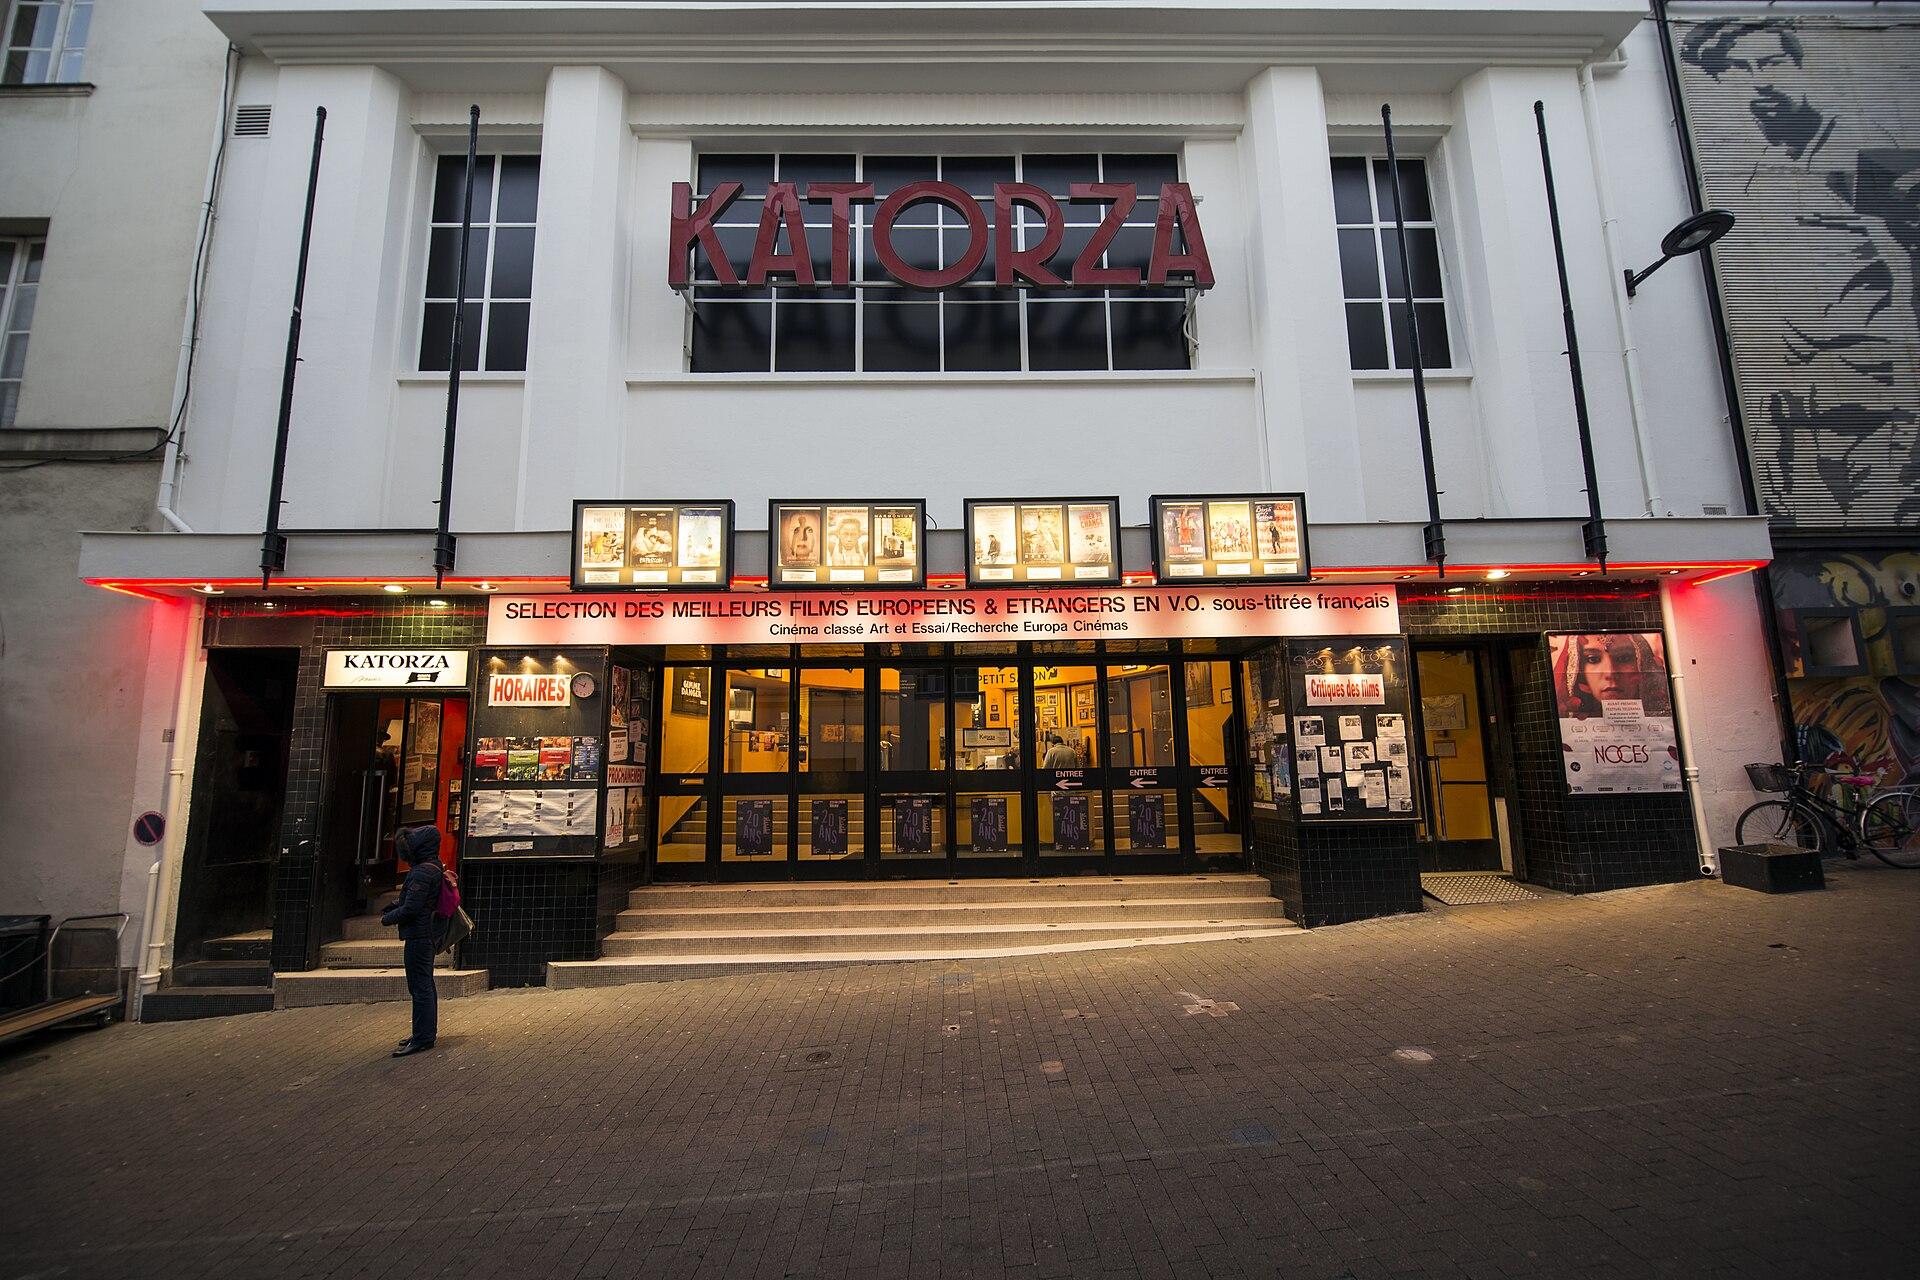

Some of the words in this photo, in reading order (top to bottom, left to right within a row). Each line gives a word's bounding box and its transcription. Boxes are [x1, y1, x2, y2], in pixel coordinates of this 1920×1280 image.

[668, 181, 1215, 290] KATORZA
[505, 602, 616, 619] SELECTION
[624, 601, 664, 618] DES
[672, 601, 782, 618] MEILLEURS
[790, 600, 848, 617] FILMS
[857, 598, 976, 616] EUROPEENS
[984, 598, 998, 615] &
[1006, 597, 1126, 614] ETRANGERS
[1134, 597, 1160, 612] EN
[1168, 596, 1205, 611] V.O.
[1212, 594, 1312, 611] sous-titrée
[1317, 592, 1389, 611] français
[769, 623, 819, 635] Cinéma
[823, 623, 864, 635] classé
[870, 623, 890, 634] Art
[894, 624, 907, 634] et
[912, 621, 1019, 634] Essai/Recherche
[1024, 621, 1068, 634] Europa
[1073, 619, 1129, 632] Cinémas
[344, 654, 450, 669] KATORZA
[493, 677, 566, 702] HORAIRES
[1310, 679, 1345, 702] Critiques
[1346, 679, 1361, 698] des
[1361, 679, 1380, 698] films
[1594, 744, 1649, 764] NOCES
[1055, 770, 1084, 778] ENTREE
[1200, 767, 1229, 775] ENTREE
[746, 810, 759, 827] 20
[821, 809, 835, 827] 20
[905, 809, 918, 826] 20
[981, 807, 994, 825] 20
[1063, 805, 1076, 823] 20
[1138, 803, 1152, 822] 20
[743, 824, 762, 845] ANS
[819, 824, 837, 844] ANS
[902, 823, 921, 842] ANS
[979, 822, 997, 841] ANS
[1060, 820, 1079, 840] ANS
[1137, 819, 1156, 838] ANS
